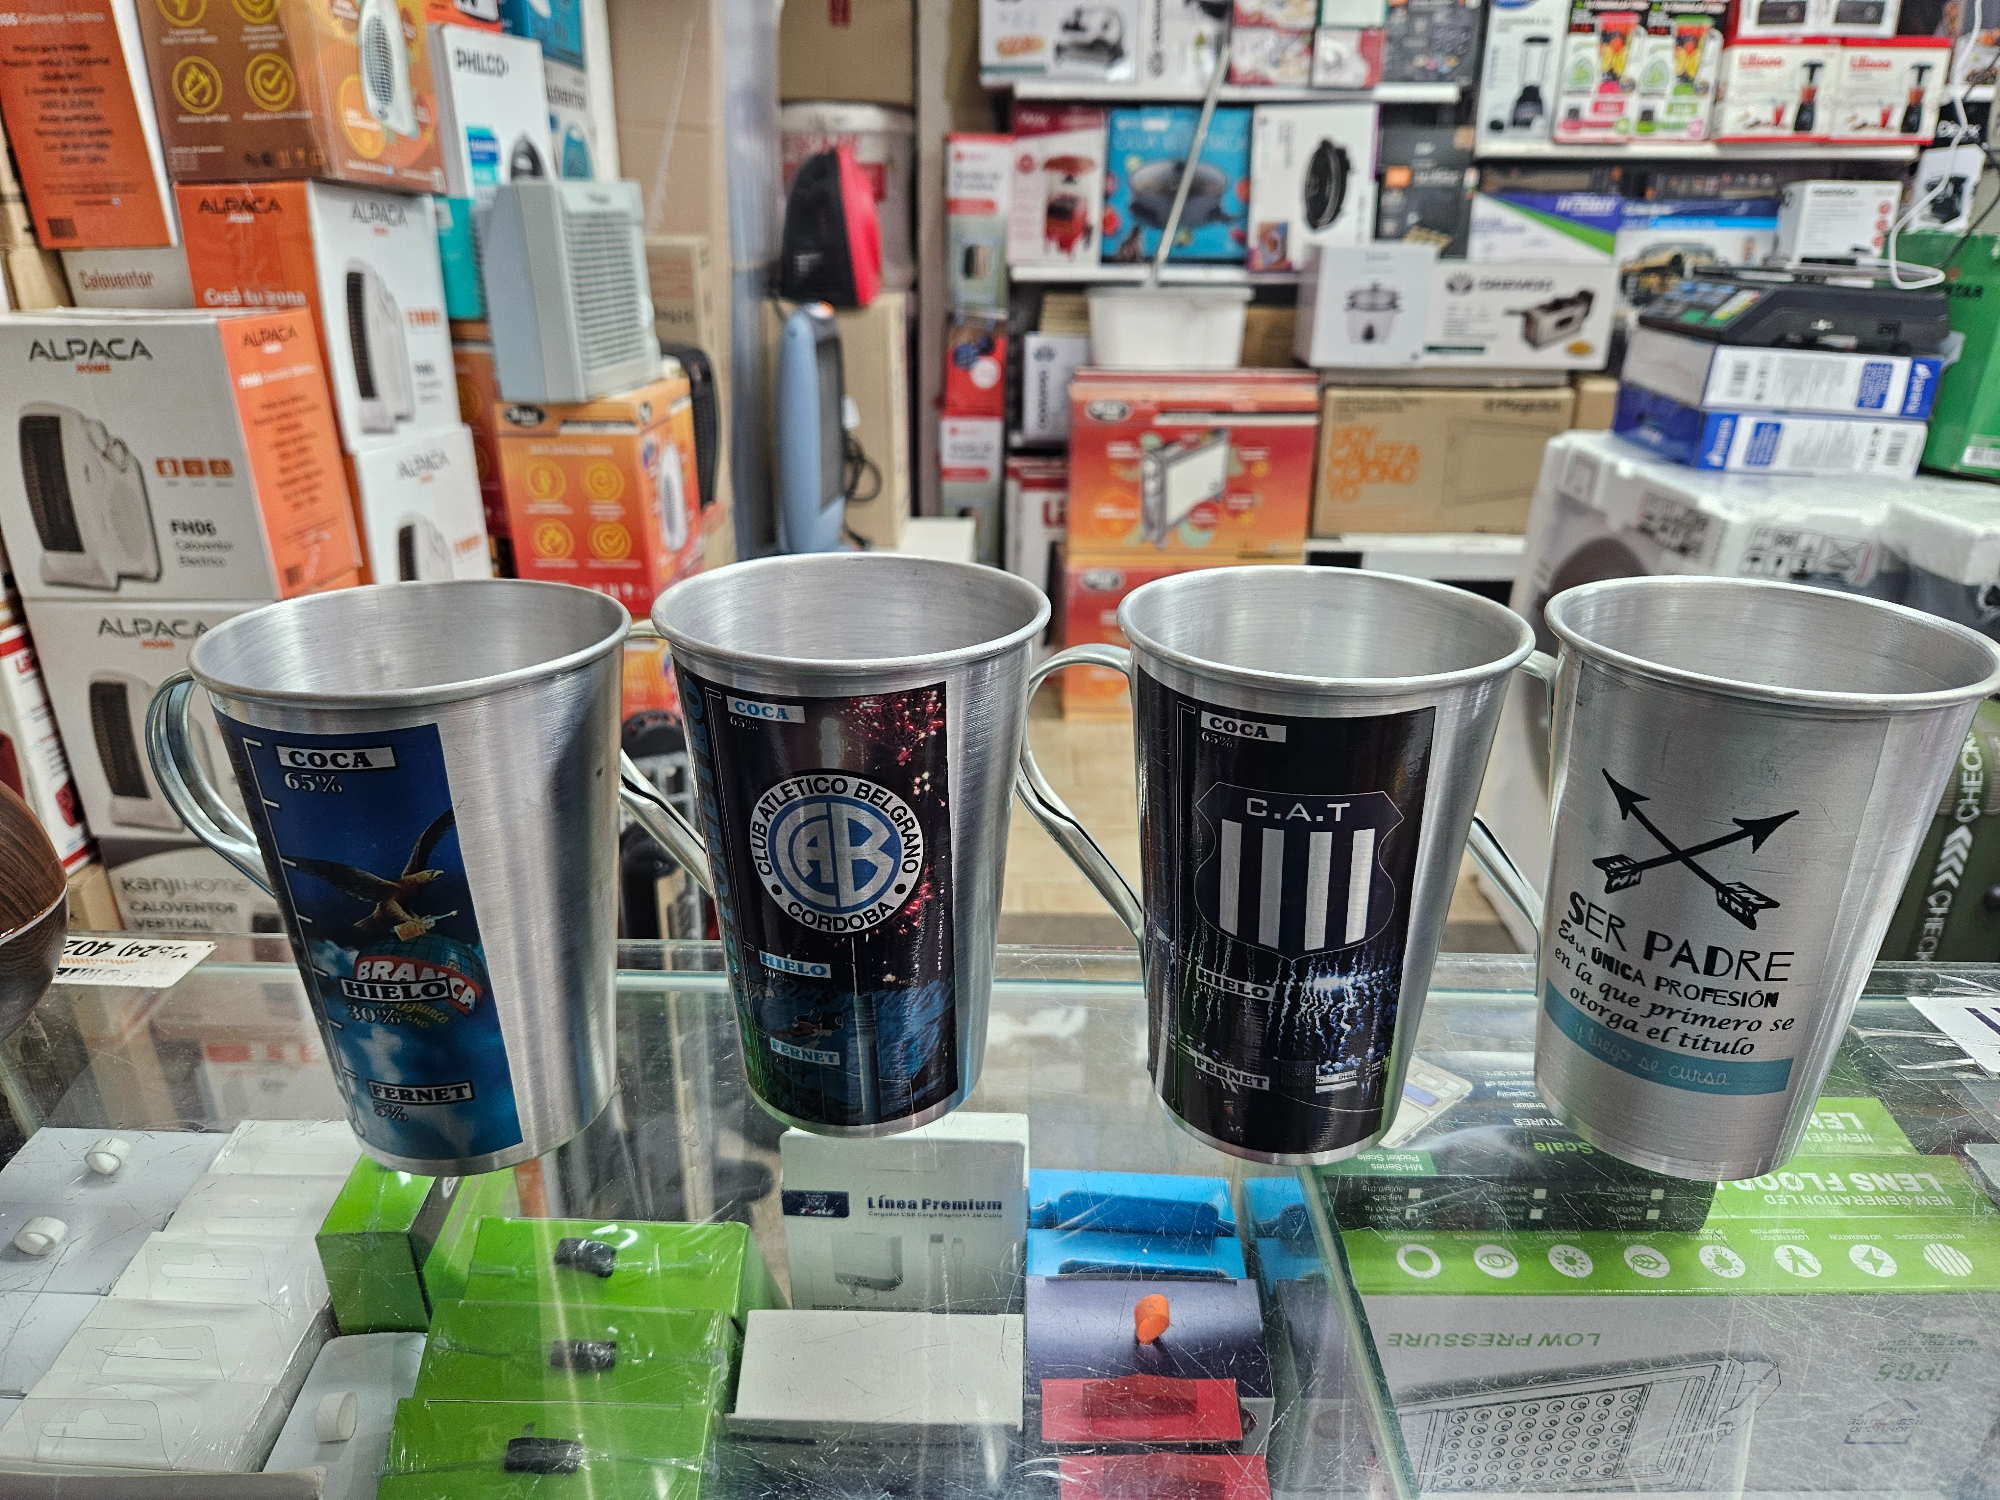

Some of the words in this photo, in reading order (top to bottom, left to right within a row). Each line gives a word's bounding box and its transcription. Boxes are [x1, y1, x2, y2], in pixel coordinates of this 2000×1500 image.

[456, 47, 506, 77] PHILCO
[198, 197, 283, 214] ALPACA
[351, 201, 408, 227] ALPACA
[242, 324, 299, 347] ALPACA
[29, 338, 153, 362] ALPACA
[171, 519, 217, 537] FH06
[98, 617, 211, 641] ALPACA
[734, 701, 789, 720] COCA
[729, 715, 759, 731] 65%
[1209, 716, 1270, 739] COCA
[1201, 730, 1233, 748] 65%
[288, 750, 373, 769] COCA
[284, 772, 343, 794] 65%
[1246, 797, 1350, 823] C.A.T
[751, 820, 774, 876] CLUB
[763, 777, 848, 823] ATLETICO
[853, 780, 921, 874] BELGRANO
[129, 900, 238, 914] CALOVENTOR
[787, 900, 895, 932] CORDOBA
[134, 917, 213, 930] VERTICAL
[1567, 891, 1627, 951] SER
[1644, 930, 1795, 982] PADRE
[761, 952, 827, 977] HIELO
[345, 980, 447, 1000] HIELO
[1200, 968, 1270, 998] HIELO
[1555, 947, 1572, 971] en
[1575, 963, 1593, 986] la
[1599, 981, 1641, 1008] que
[1640, 1001, 1763, 1032] primero
[1770, 1017, 1795, 1032] se
[1654, 975, 1780, 1008] PROFESIÓN
[1569, 986, 1639, 1034] otorga
[1646, 1026, 1673, 1043] el
[771, 1039, 837, 1063] FERNET
[1198, 1059, 1267, 1088] FERNET
[1668, 1064, 1730, 1086] cursa
[370, 1083, 468, 1101] FERNET
[373, 1101, 409, 1122] 5%
[1836, 1132, 1874, 1143] NEW
[1533, 1142, 1594, 1155] Scale
[1370, 1163, 1423, 1171] MH-Series
[1737, 1172, 1846, 1191] FLOOD
[1849, 1172, 1944, 1193] LENS
[867, 1194, 918, 1210] Línea
[922, 1197, 1003, 1210] Premium
[1764, 1194, 1797, 1205] LED
[1798, 1194, 1911, 1205] GENERATION
[1914, 1195, 1955, 1206] NEW
[1387, 1332, 1536, 1347] PRESSURE
[1539, 1333, 1601, 1347] LOW
